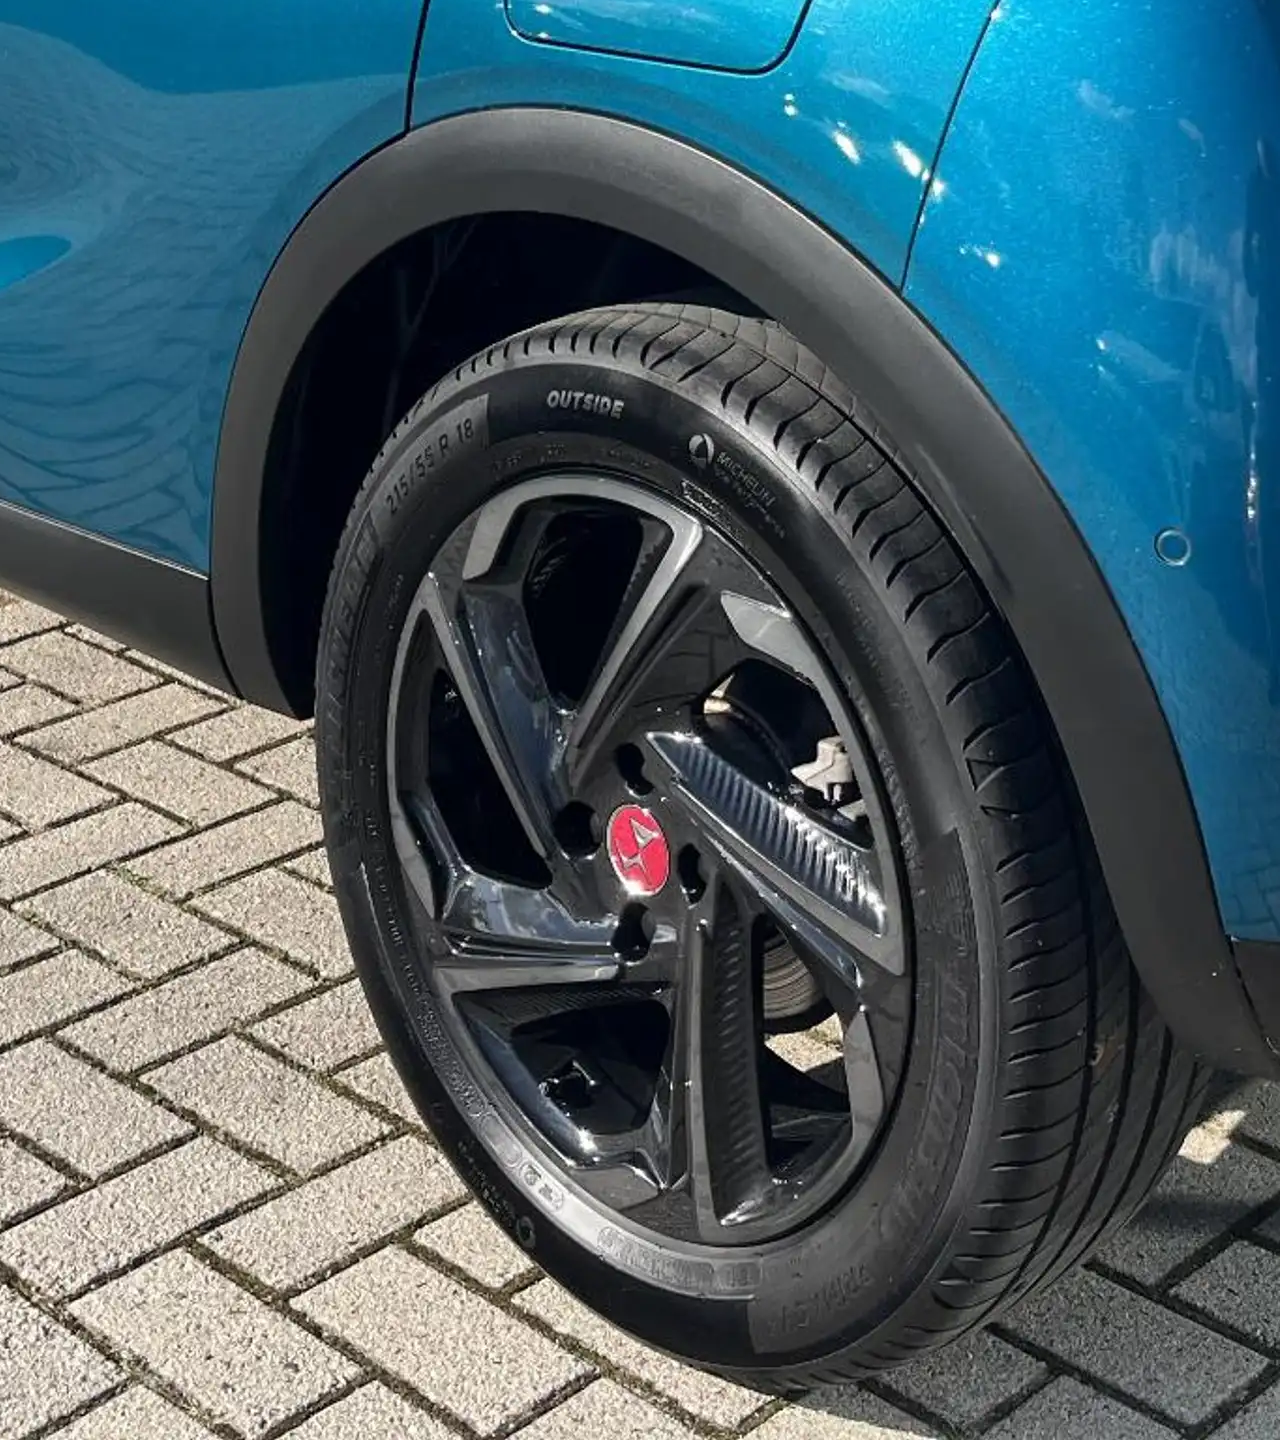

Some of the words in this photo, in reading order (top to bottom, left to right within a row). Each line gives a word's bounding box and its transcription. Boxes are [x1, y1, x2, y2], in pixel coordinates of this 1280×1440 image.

[547, 389, 625, 419] OUTSIDE
[457, 418, 475, 443] 18
[715, 451, 776, 508] MICHELIN
